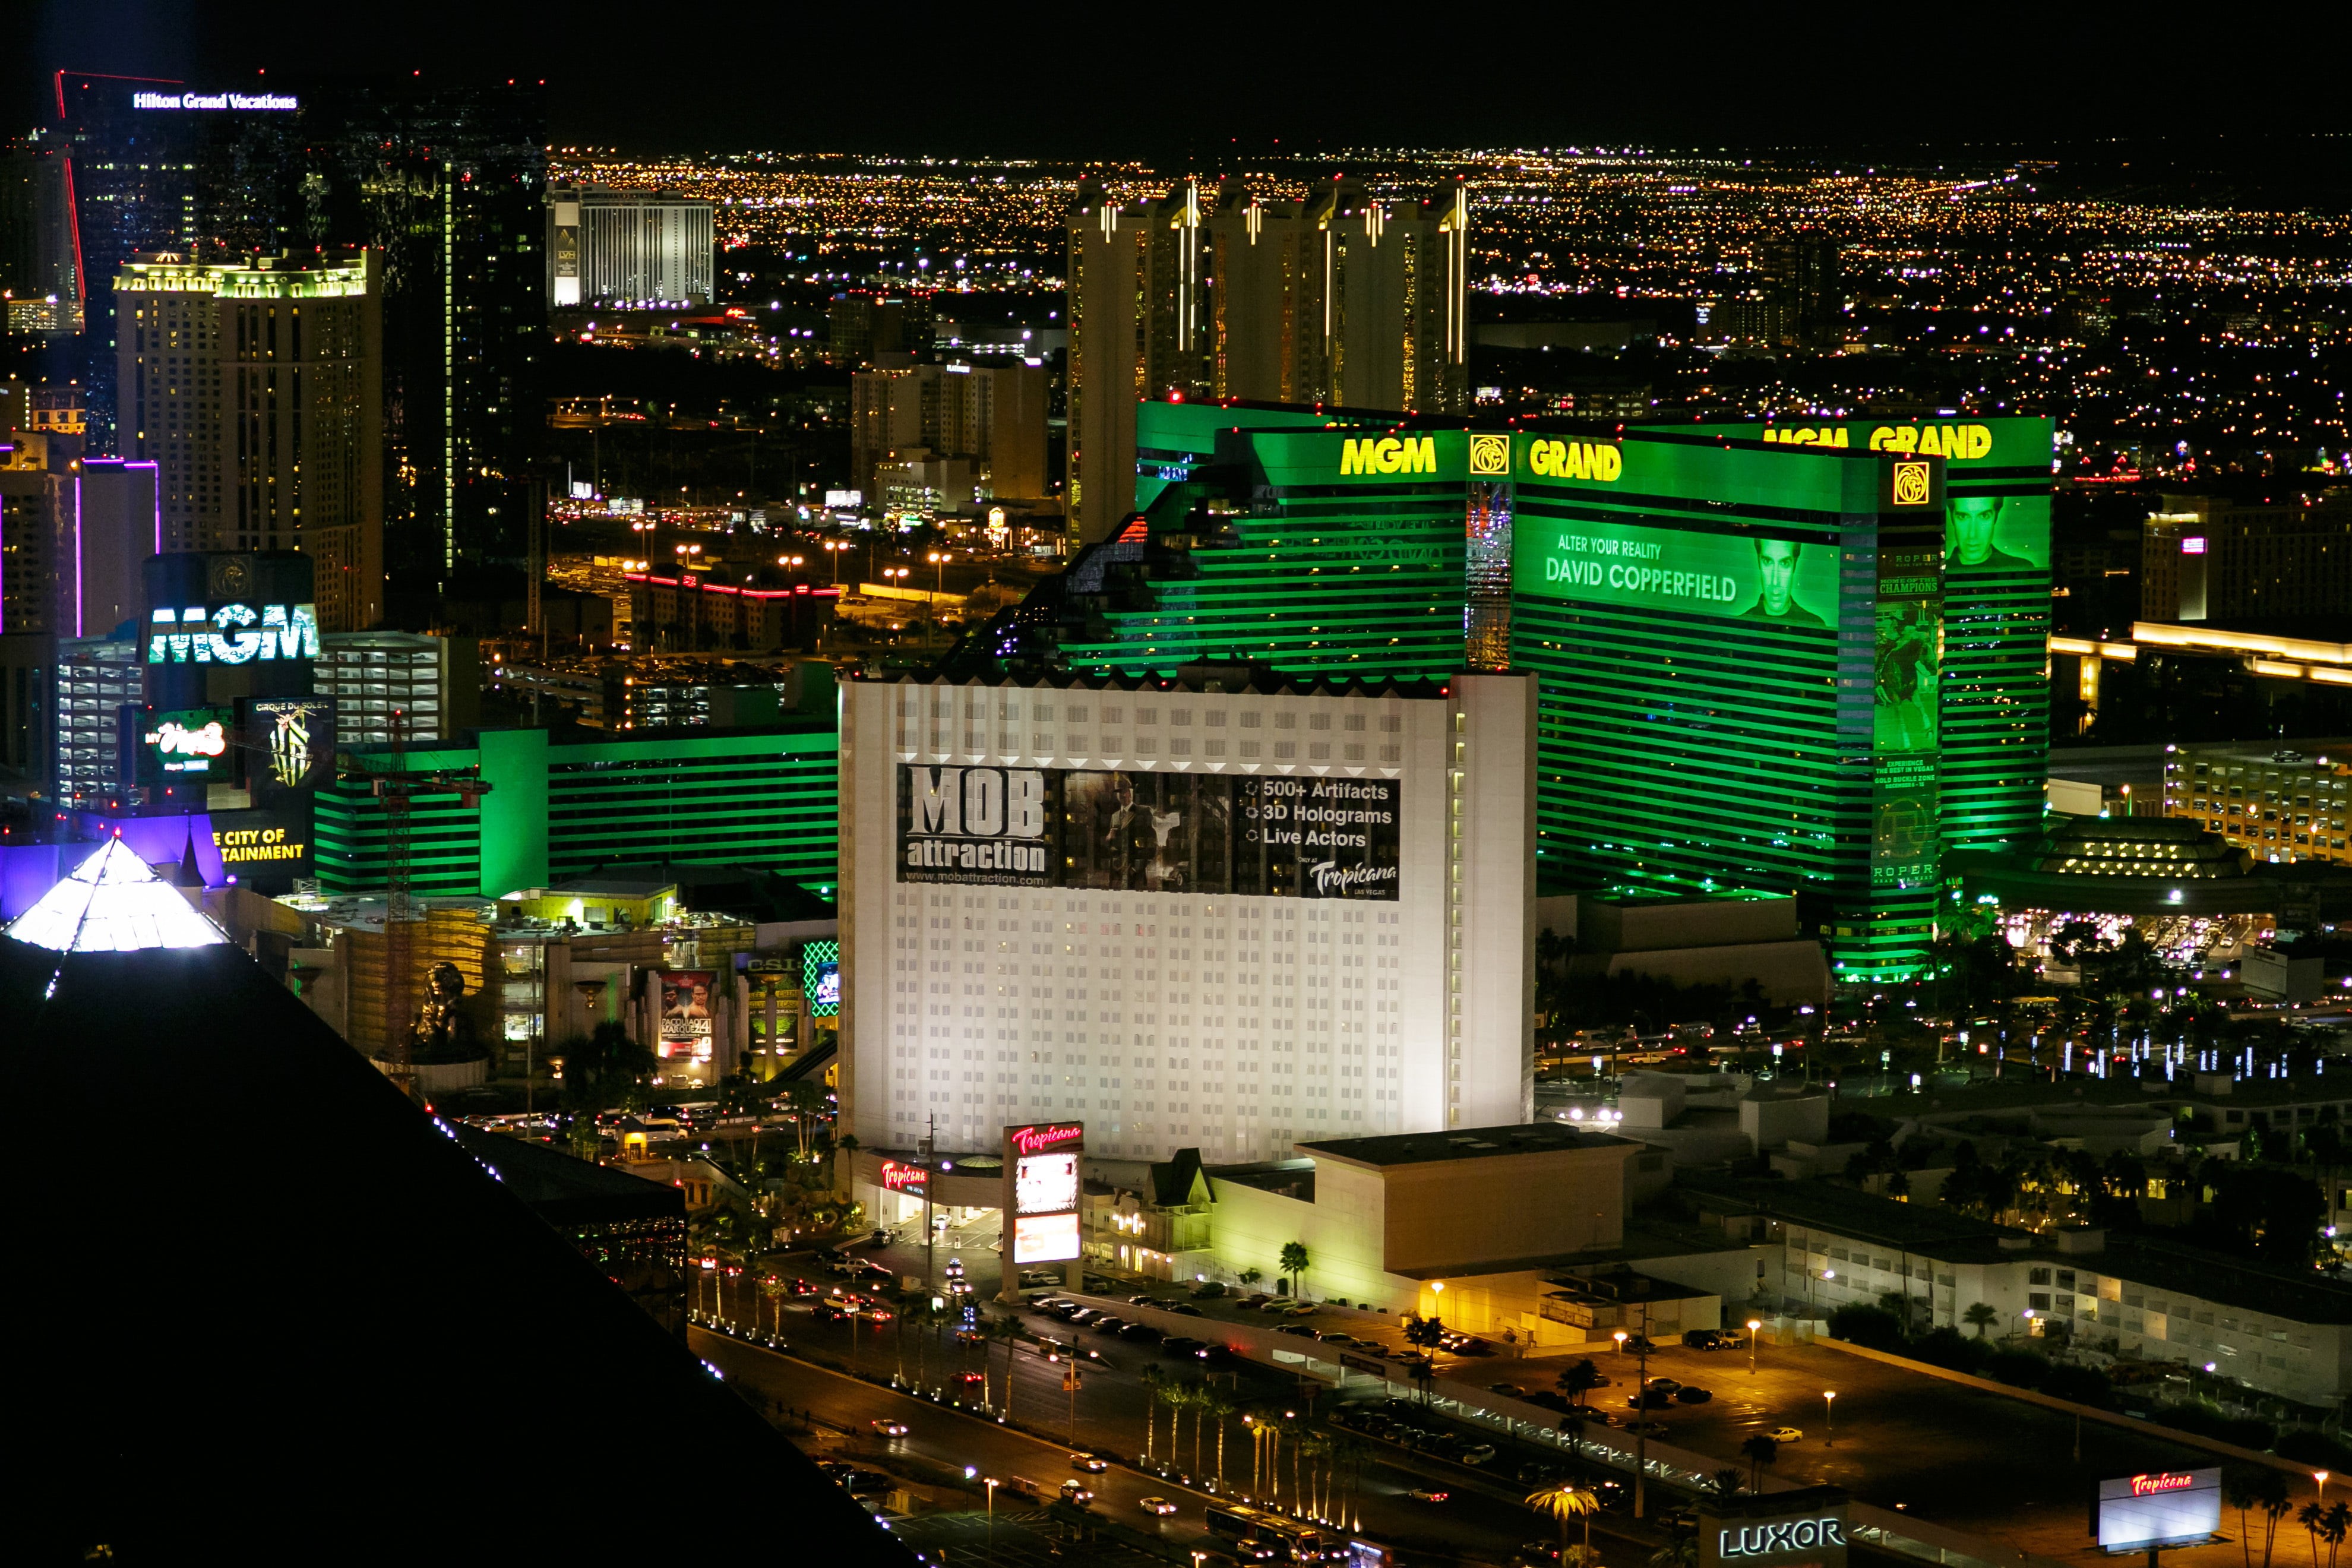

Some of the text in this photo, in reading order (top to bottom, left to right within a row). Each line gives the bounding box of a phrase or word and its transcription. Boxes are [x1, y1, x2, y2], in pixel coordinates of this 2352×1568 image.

[134, 93, 297, 109] Hilton Grand Vacations
[1869, 424, 1992, 459] GRAND
[1340, 437, 1623, 482] MGM GRAND
[1558, 535, 1662, 560] ALTER YOUR REALITY
[1546, 557, 1736, 602] DAVID COPPERFIELD
[1880, 582, 1937, 594] CHAMPIONS
[148, 603, 321, 665] MGM
[255, 703, 286, 713] CIRQUE
[287, 702, 299, 710] DU
[907, 766, 1044, 837] MOB
[1263, 781, 1389, 800] 500+ Artifacts
[1263, 804, 1392, 826] 3D Holograms
[225, 830, 259, 846] CITY
[262, 829, 285, 843] OF
[1264, 828, 1366, 847] Live Actors
[907, 840, 1045, 872] attraction
[906, 872, 1044, 886] www.mobattraction.com
[1310, 861, 1396, 896] Tropicana
[1873, 864, 1933, 877] ROPER
[1012, 1126, 1081, 1154] Tropicana
[881, 1161, 926, 1188] Tropicana
[2132, 1473, 2192, 1496] Tropicana
[1720, 1518, 1847, 1558] LUXOR
